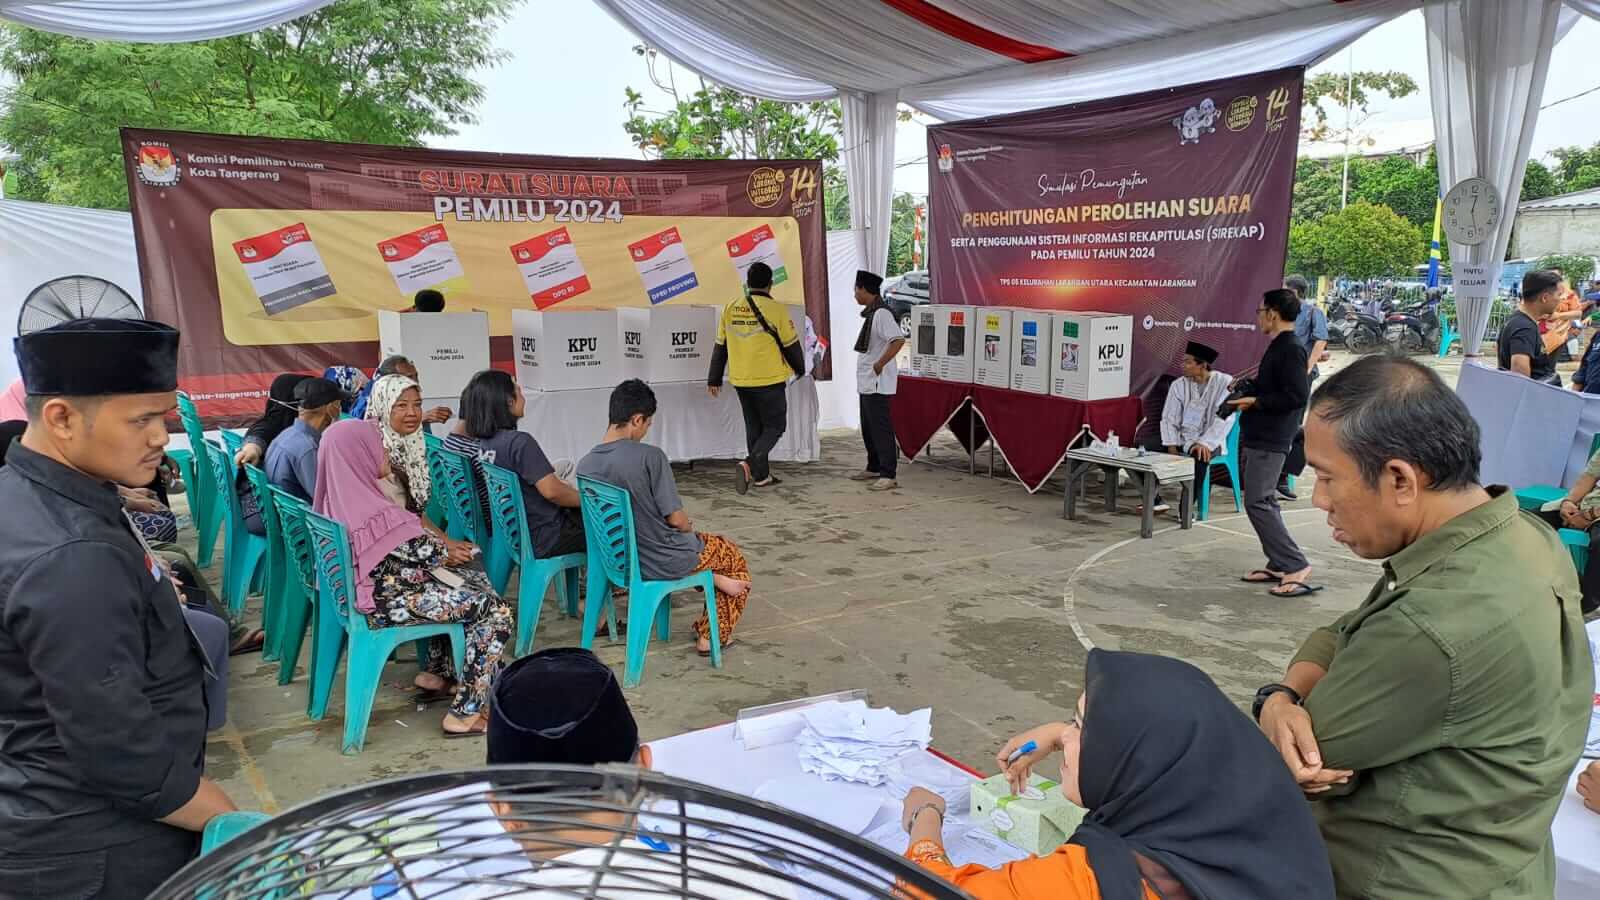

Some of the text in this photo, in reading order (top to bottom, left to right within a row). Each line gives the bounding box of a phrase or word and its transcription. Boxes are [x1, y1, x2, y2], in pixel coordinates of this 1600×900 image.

[1265, 87, 1290, 121] 14
[187, 153, 228, 165] Komisi
[230, 155, 286, 168] Pemilihan
[190, 168, 280, 182] Kota Tangerang
[419, 170, 634, 198] SURAT SUARA
[789, 166, 818, 201] 14
[1037, 168, 1148, 199] Simulasi Pemungutan
[1471, 185, 1479, 194] 12
[433, 196, 625, 223] PEMILU 2024
[961, 193, 1252, 228] PENGHITUNGAN PEROLEHAN SUARA
[950, 222, 1265, 248] SERTA PENGGUNAAN SISTEM INFORMASI REKAPITULASI (SIREKAP)
[1031, 247, 1155, 260] PADA PEMILU TAHUN 2024
[1114, 279, 1159, 287] KECAMATAN
[1159, 280, 1198, 288] LARANGAN
[520, 336, 536, 352] KPU
[567, 337, 598, 352] KPU
[624, 331, 641, 345] KPU
[672, 331, 697, 345] KPU
[1098, 343, 1124, 360] KPU
